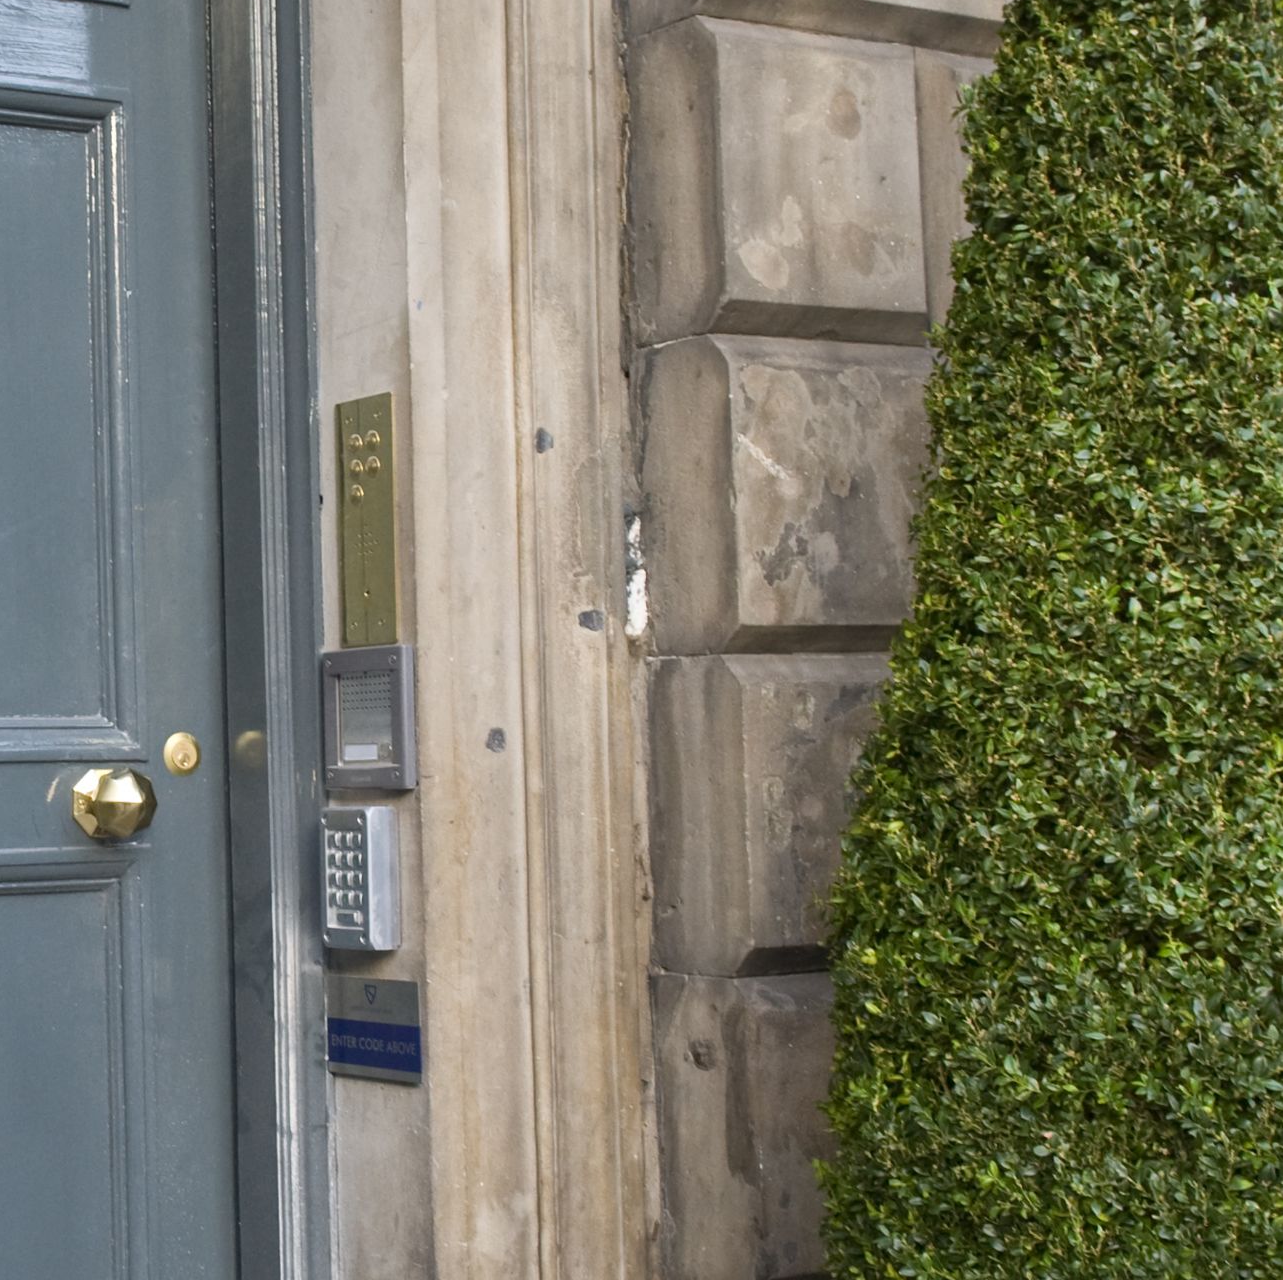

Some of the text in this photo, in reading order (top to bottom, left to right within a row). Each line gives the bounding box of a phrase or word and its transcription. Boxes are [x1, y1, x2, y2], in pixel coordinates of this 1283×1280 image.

[331, 1033, 416, 1056] ENTER CODE ABOVE
